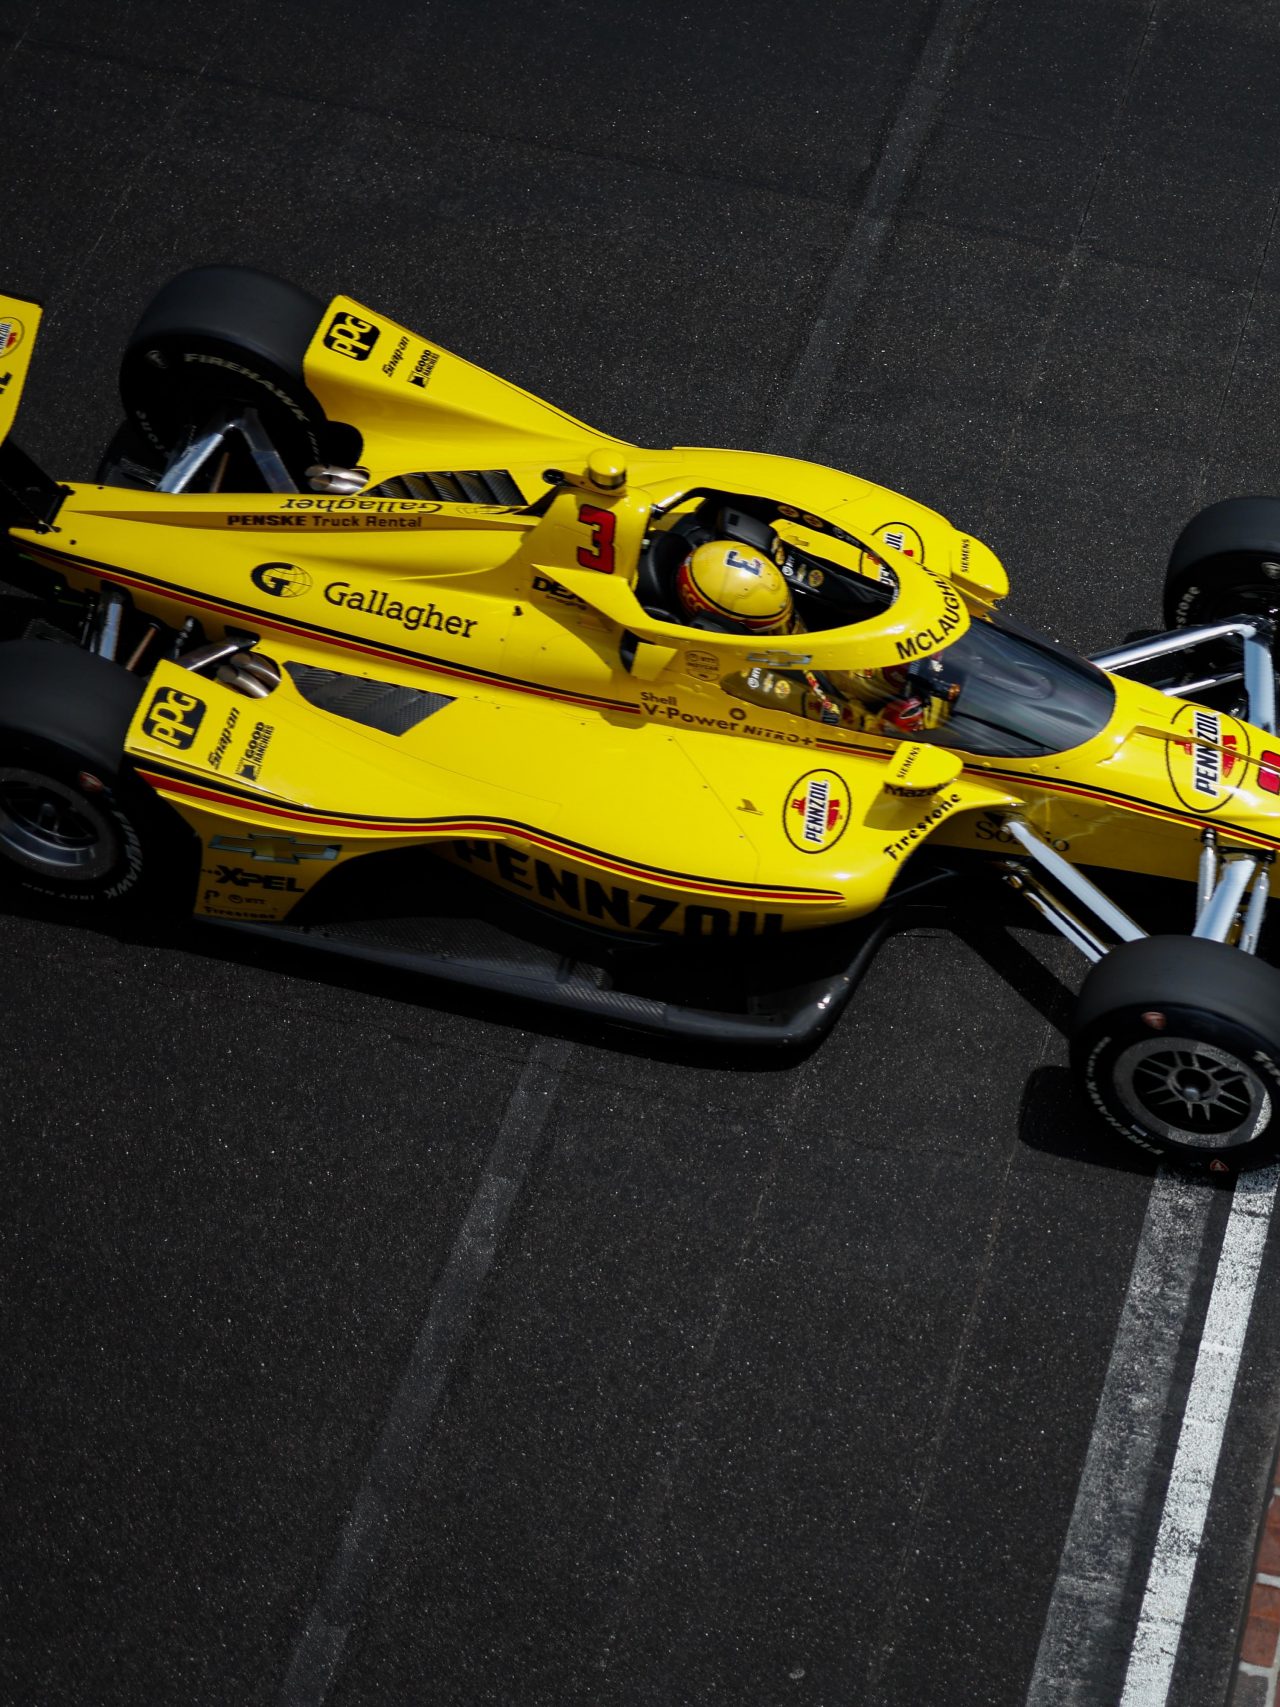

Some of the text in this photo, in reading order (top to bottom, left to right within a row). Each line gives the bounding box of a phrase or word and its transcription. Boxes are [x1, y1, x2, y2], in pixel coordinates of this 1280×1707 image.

[328, 314, 373, 359] PPG
[415, 350, 431, 373] GOOD
[227, 515, 422, 528] PENSKE Truck Rental
[280, 498, 443, 513] Gallagher
[577, 504, 616, 574] 3
[961, 538, 970, 573] SIEMENS
[323, 581, 478, 638] Gallagher
[640, 691, 678, 706] Shell
[642, 702, 740, 731] V-Power
[149, 690, 198, 747] PPG
[208, 706, 240, 770] Snap-on
[245, 722, 264, 758] GOOD
[252, 725, 275, 763] RANCHERS
[1195, 711, 1218, 796] PENNZOIL
[897, 745, 922, 779] SIEMENS
[805, 780, 828, 842] PENNZOIL
[883, 794, 962, 860] Firestone
[216, 864, 304, 892] XPEL
